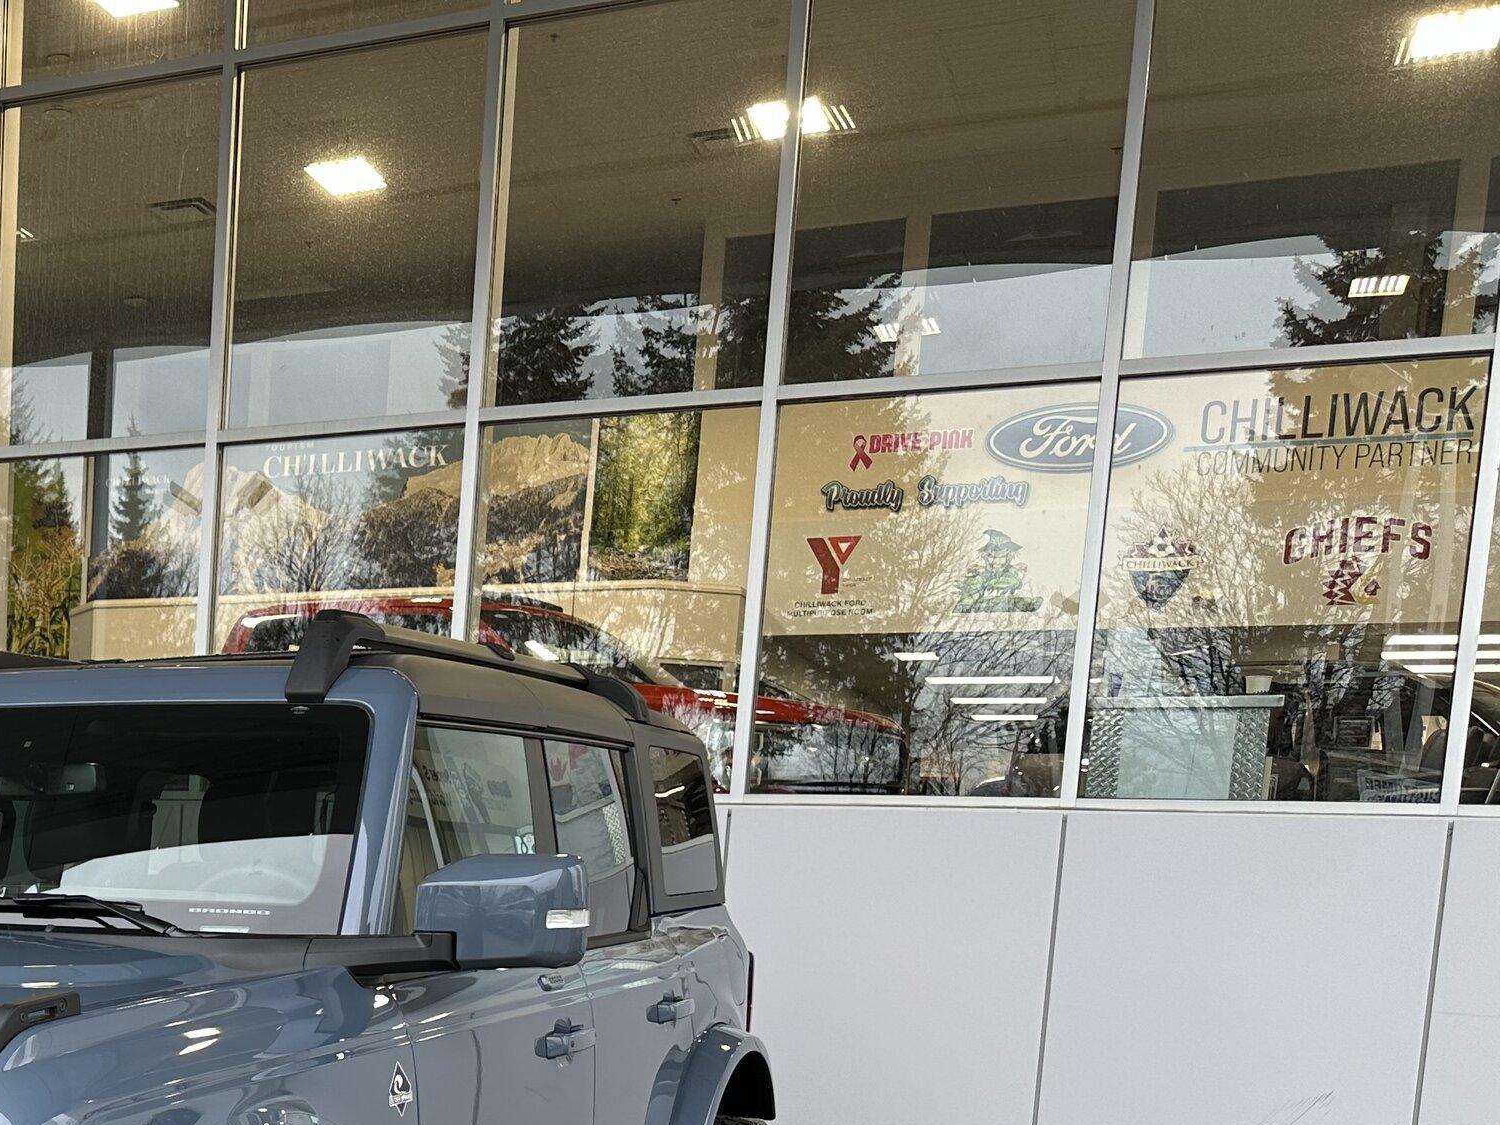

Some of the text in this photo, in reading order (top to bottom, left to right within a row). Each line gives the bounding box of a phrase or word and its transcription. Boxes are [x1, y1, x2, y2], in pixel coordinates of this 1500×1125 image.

[1200, 385, 1478, 445] CHILLIWACK
[869, 428, 975, 454] DRIVE PINK
[1019, 414, 1138, 459] Ford
[263, 444, 449, 479] CHILLIWACK
[1196, 439, 1474, 476] COMMUNITY PARTNER
[821, 474, 1030, 513] Proudly Supporting
[1283, 516, 1433, 565] CHIEFS
[794, 599, 867, 609] CHILLIWACK FORD
